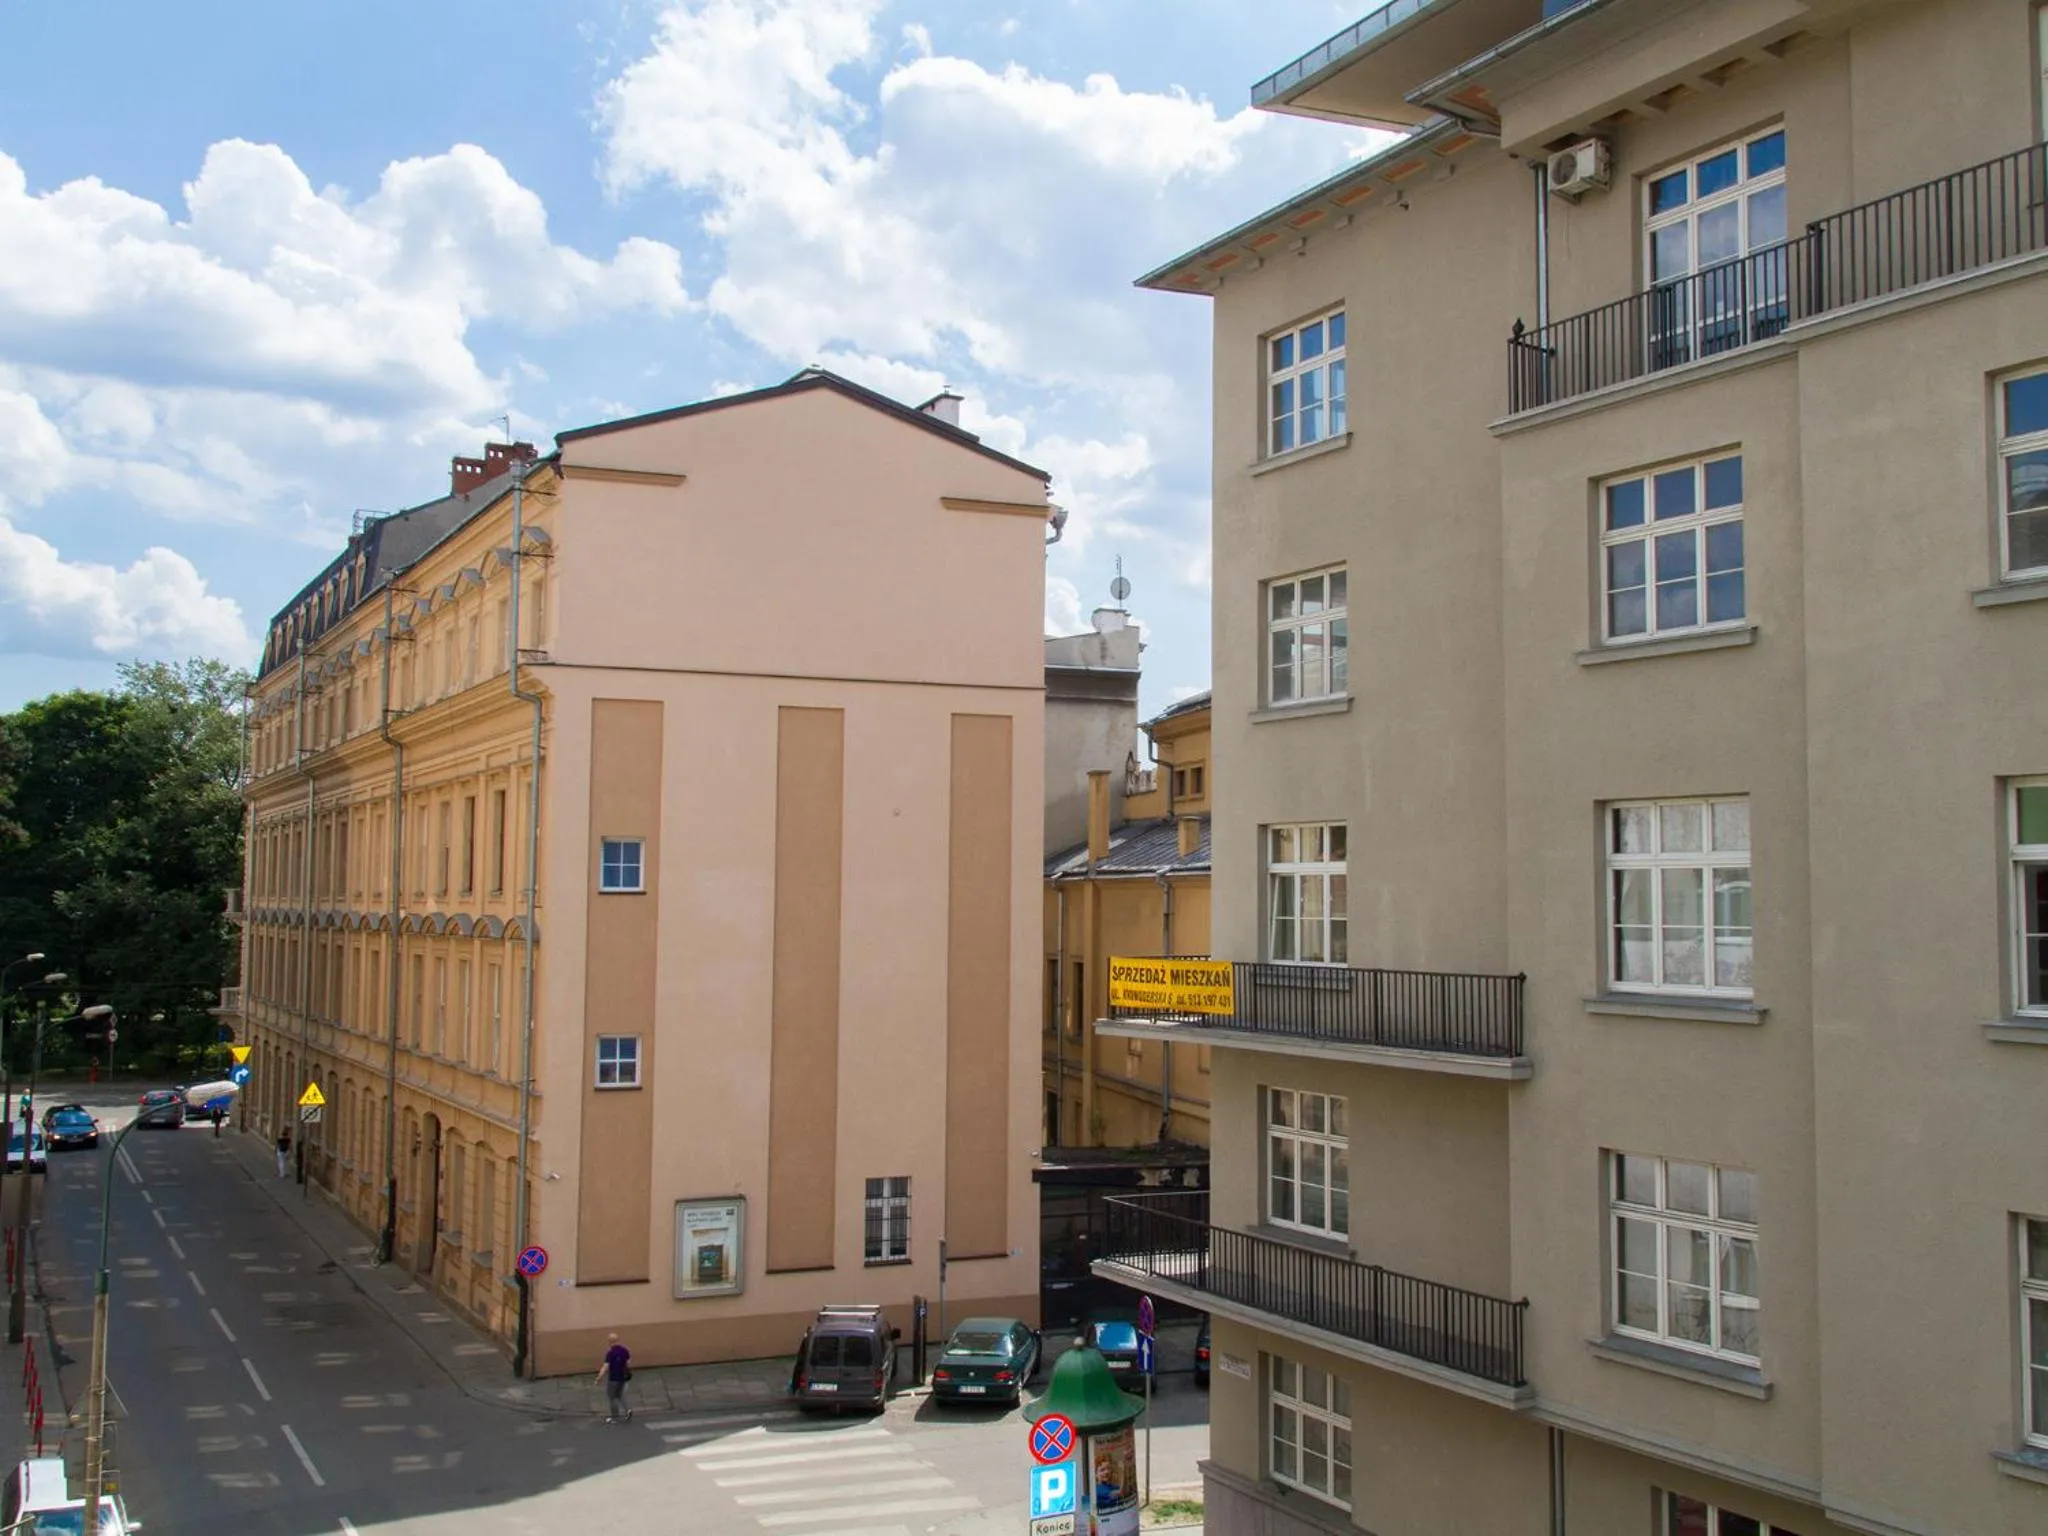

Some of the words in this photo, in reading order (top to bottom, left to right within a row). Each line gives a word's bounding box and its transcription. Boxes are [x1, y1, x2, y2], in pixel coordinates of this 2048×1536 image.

[1112, 965, 1167, 985] SPRZEDAŻ
[1170, 967, 1231, 988] MIESZKAŃ
[1040, 1469, 1068, 1512] P
[1036, 1521, 1070, 1535] Koniec
